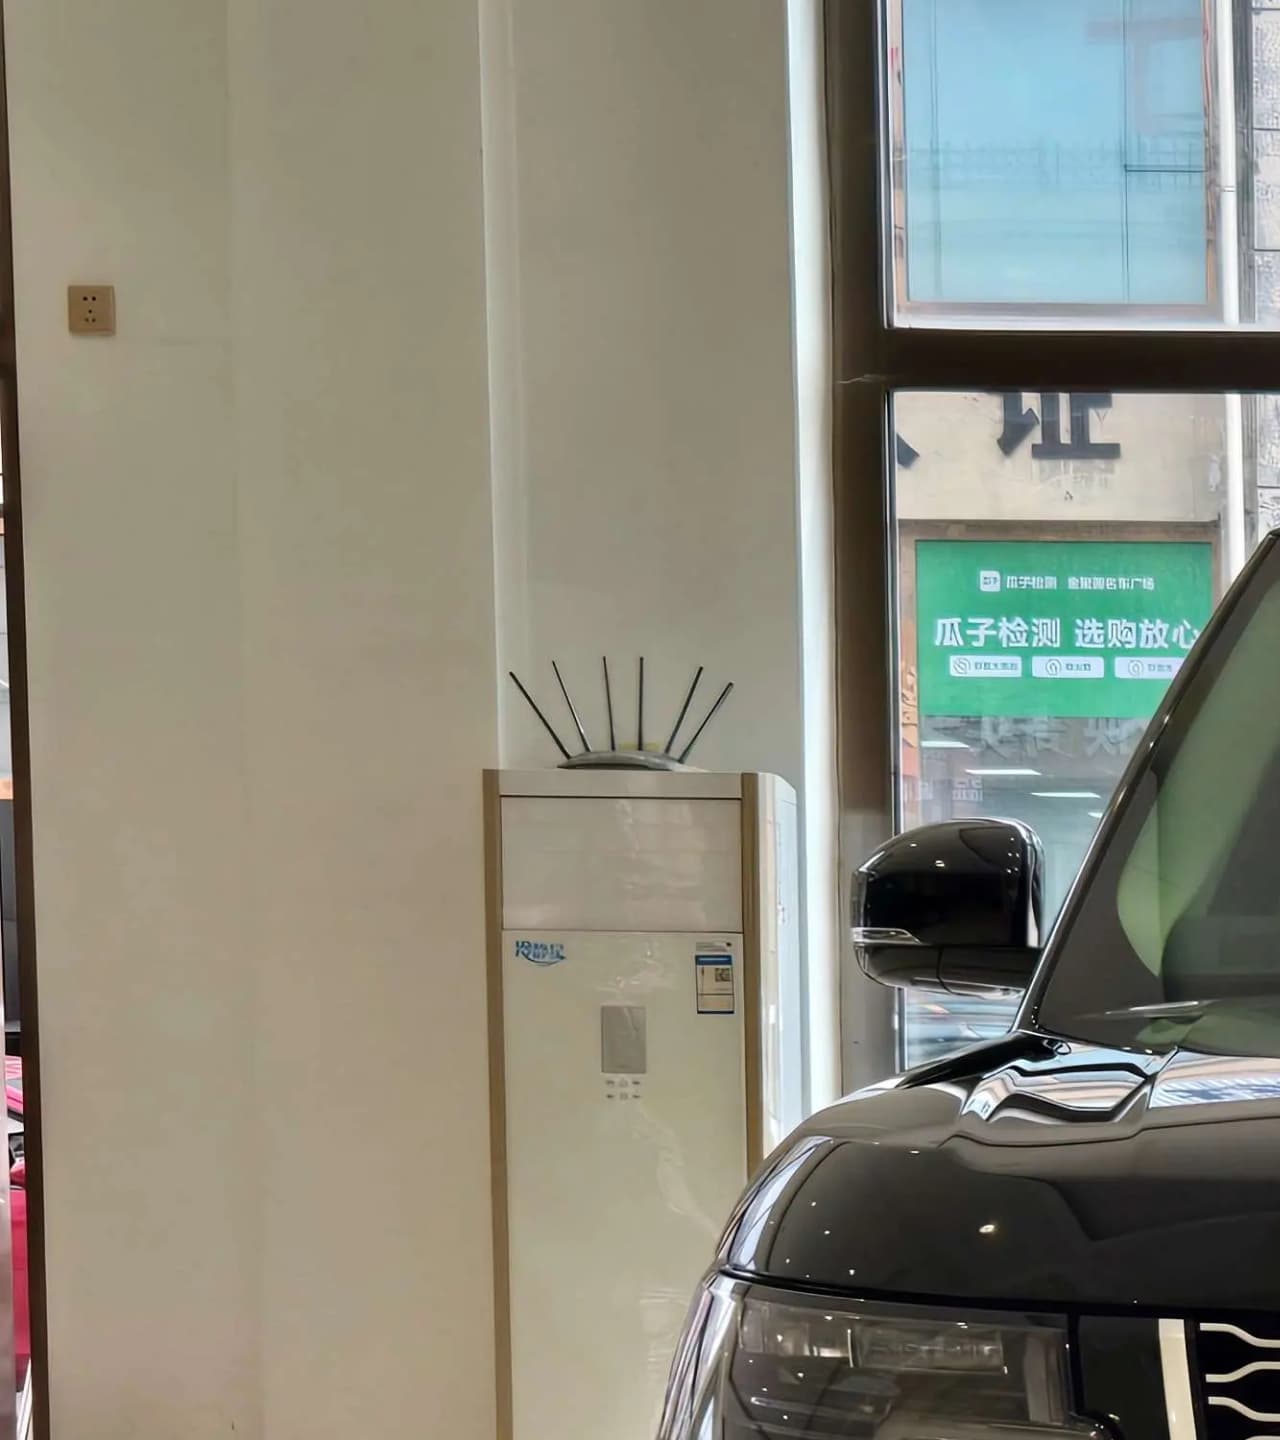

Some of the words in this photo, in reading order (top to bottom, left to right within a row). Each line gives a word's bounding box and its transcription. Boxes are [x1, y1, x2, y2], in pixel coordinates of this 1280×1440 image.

[934, 617, 1061, 649] 瓜子检测
[1074, 617, 1201, 649] 选购放心
